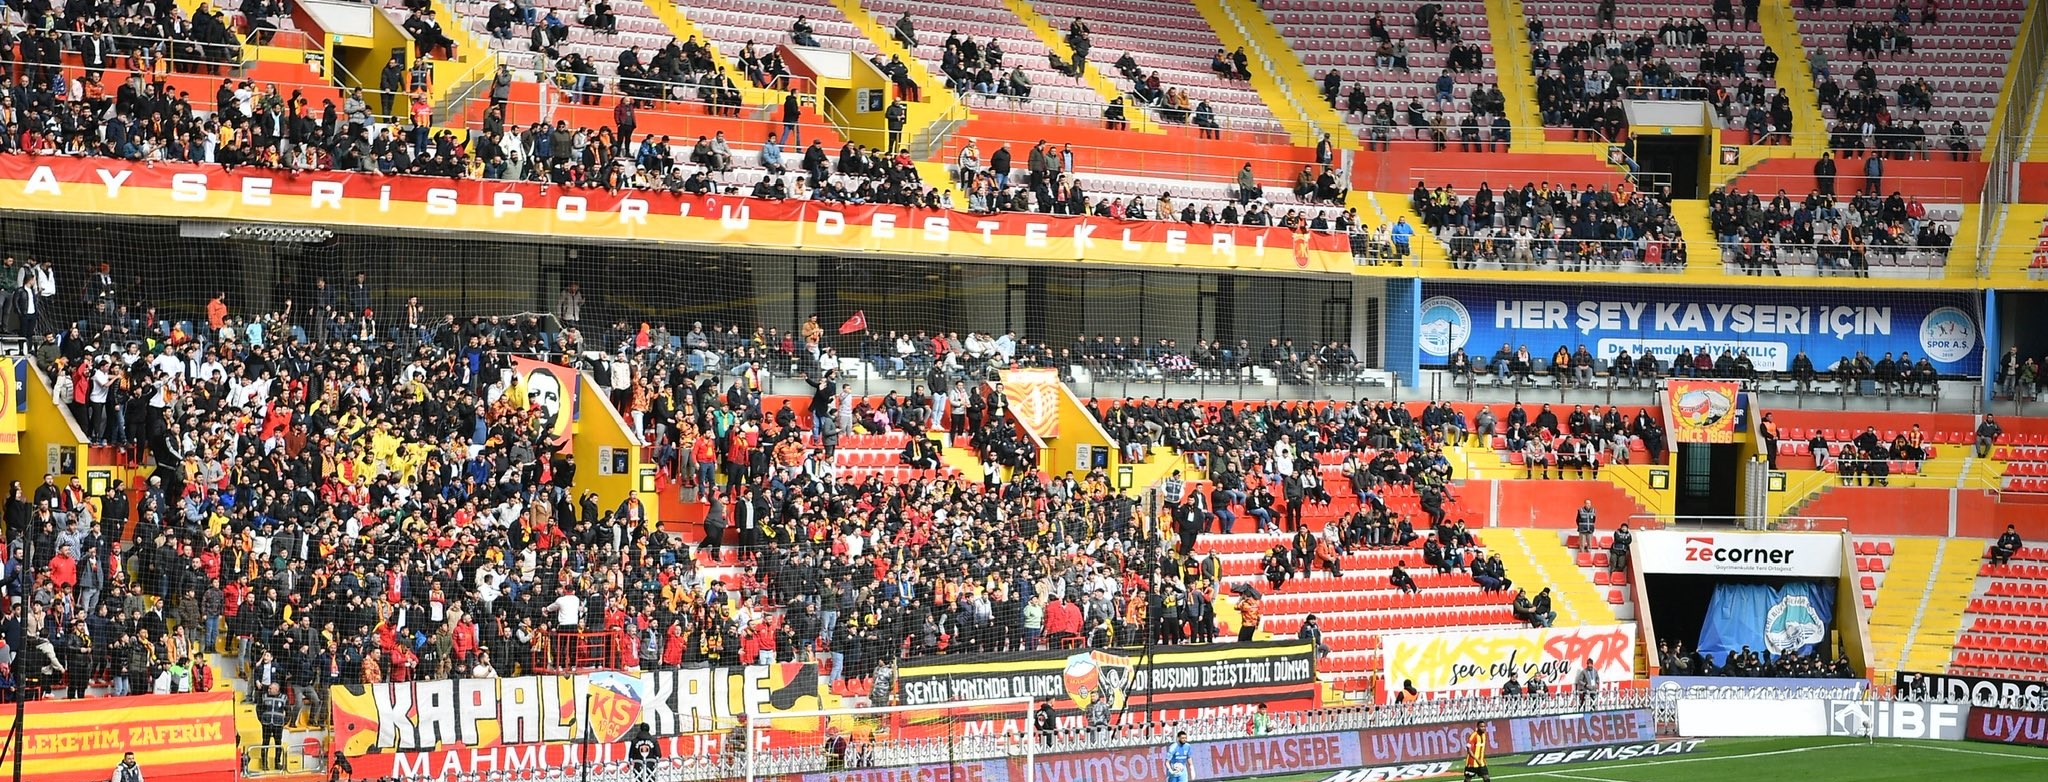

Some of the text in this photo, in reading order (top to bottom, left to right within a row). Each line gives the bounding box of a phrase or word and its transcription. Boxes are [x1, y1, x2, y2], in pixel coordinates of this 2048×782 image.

[1495, 300, 1568, 329] HER
[1575, 301, 1647, 335] ŞEY
[1927, 340, 1950, 349] SPOR
[1685, 547, 1794, 564] zecorner
[905, 676, 948, 705] SENİN
[951, 677, 1010, 701] YANINDA
[1013, 674, 1063, 698] OLUNCA
[1274, 658, 1310, 681] DÜNYA
[1449, 662, 1486, 686] sen
[1489, 650, 1519, 680] çok
[640, 662, 771, 737] KALE
[129, 719, 223, 745] ZAFERİM
[1529, 712, 1639, 747] MUHASEBE
[1983, 712, 2048, 742] uyu
[1210, 735, 1341, 776] MUHASEBE
